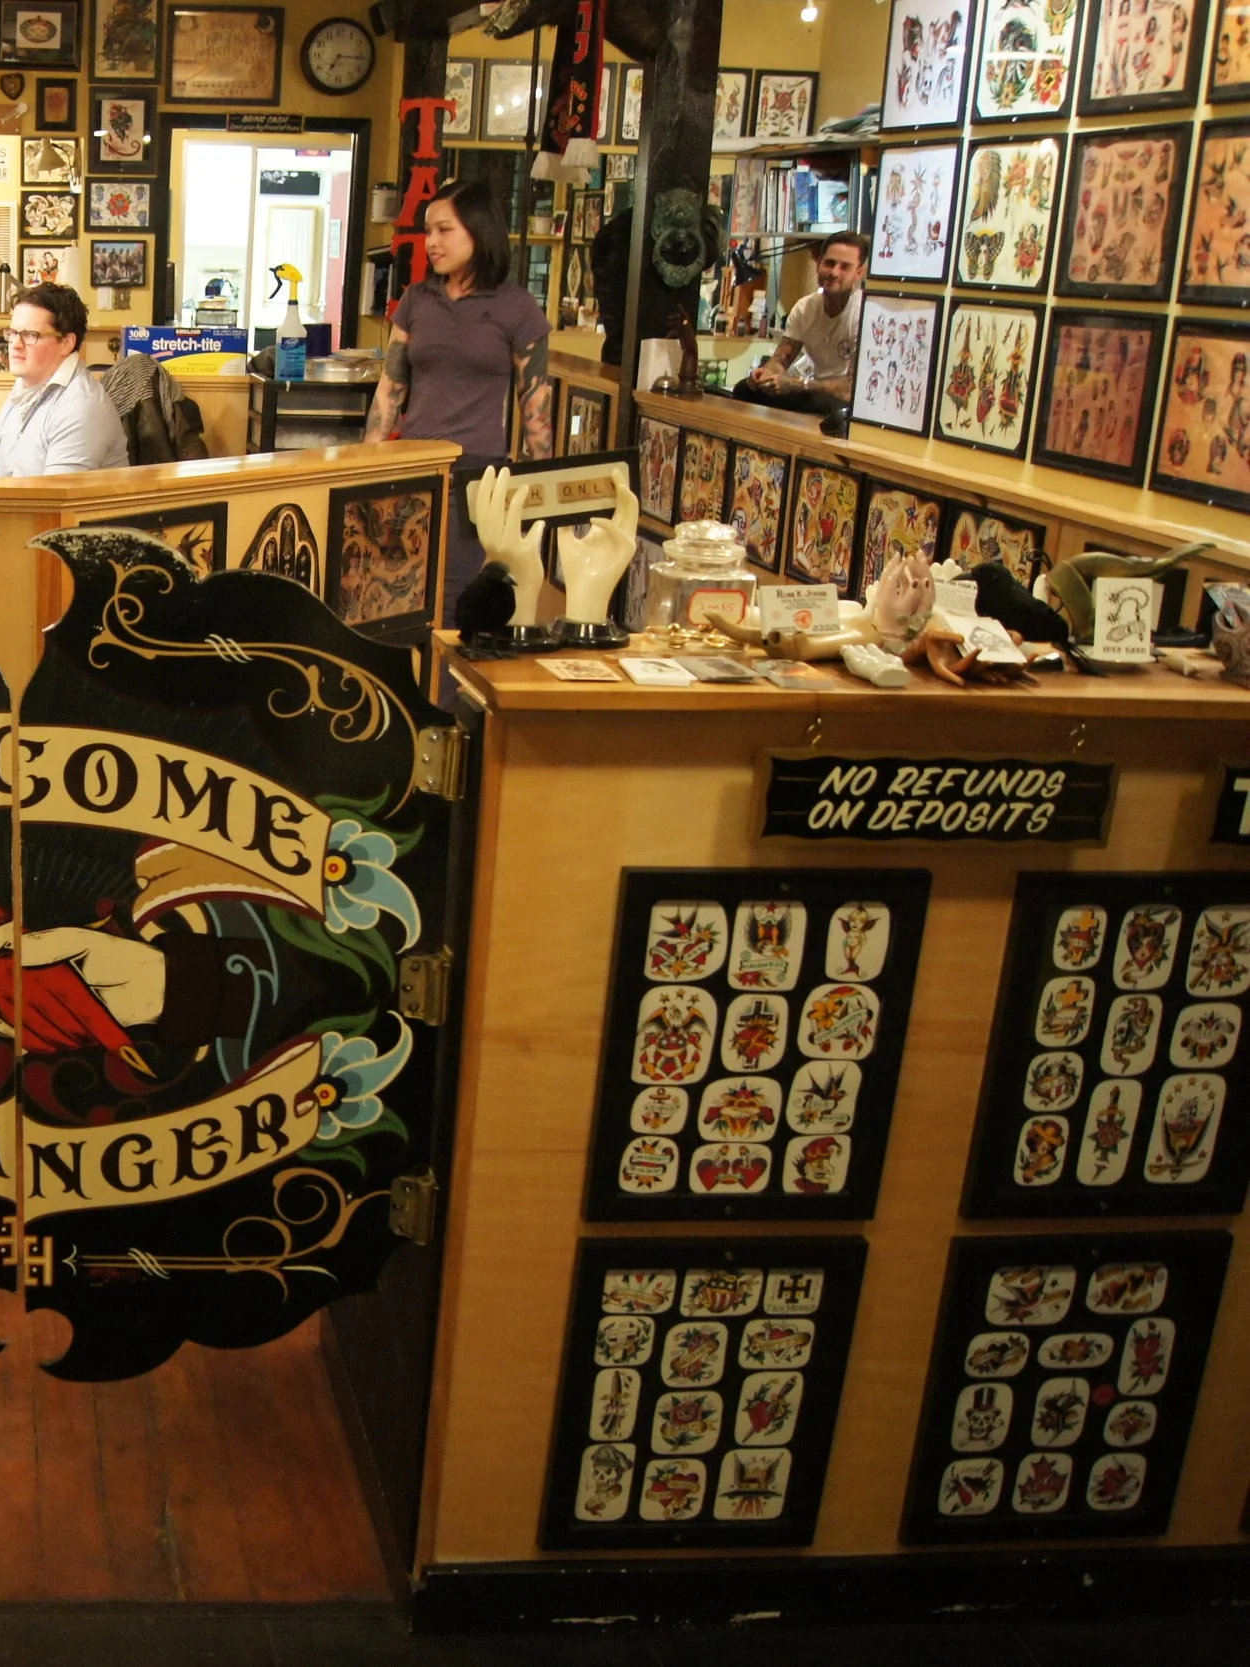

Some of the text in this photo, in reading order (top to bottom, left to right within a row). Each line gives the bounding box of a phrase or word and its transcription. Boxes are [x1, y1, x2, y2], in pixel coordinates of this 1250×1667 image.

[152, 337, 222, 352] stretch-tite
[819, 765, 1066, 798] NO REFUNDS
[808, 799, 1055, 833] ON DEPOSITS
